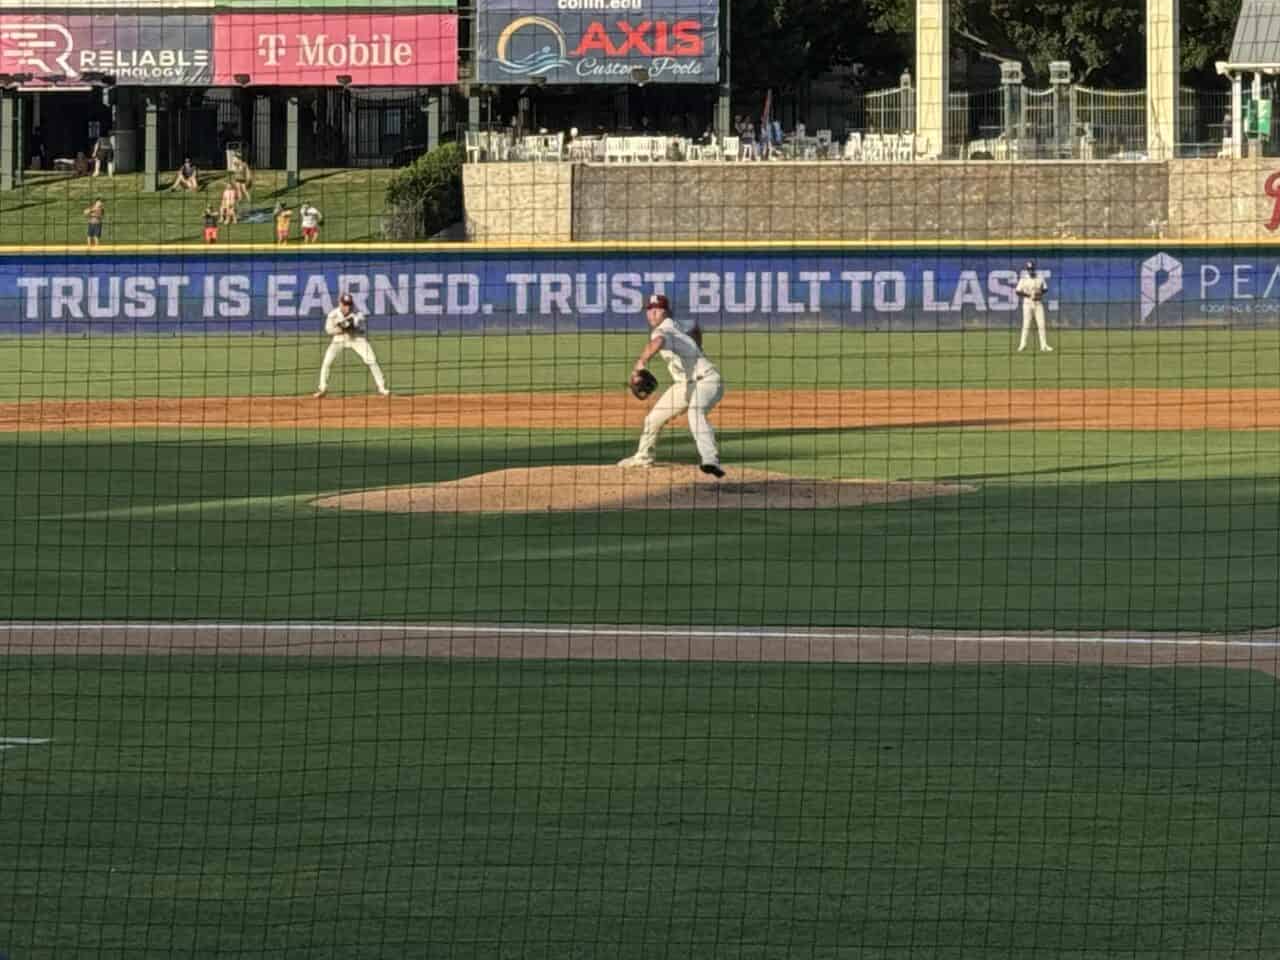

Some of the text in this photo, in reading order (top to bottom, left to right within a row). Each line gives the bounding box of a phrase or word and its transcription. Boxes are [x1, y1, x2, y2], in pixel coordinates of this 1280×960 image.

[296, 33, 413, 67] Mobile
[570, 19, 704, 57] AXIS
[79, 50, 208, 67] RELIABLE
[17, 270, 1060, 319] TRUST IS EARNED. TRUST BUILT TO LAS.
